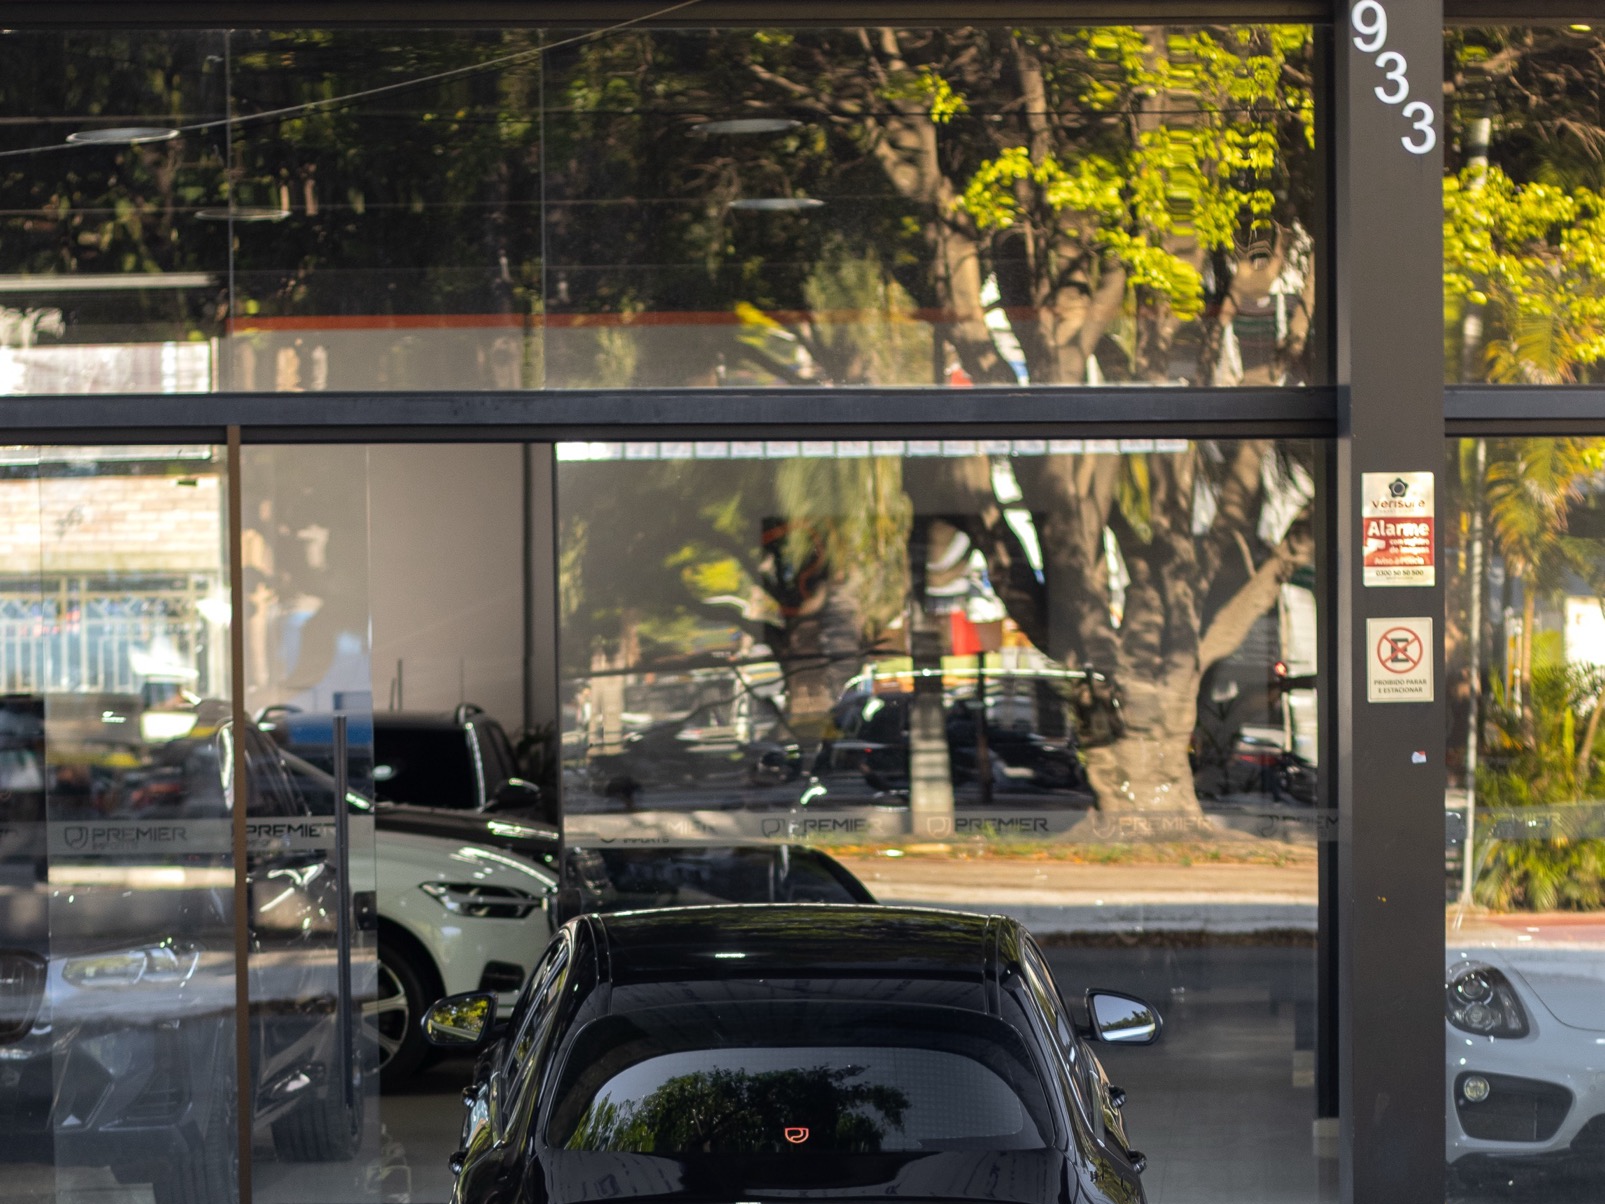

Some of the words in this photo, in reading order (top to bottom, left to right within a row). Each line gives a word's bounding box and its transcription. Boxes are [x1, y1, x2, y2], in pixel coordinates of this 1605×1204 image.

[1367, 519, 1430, 537] Alarme
[1405, 678, 1427, 686] PARAR
[1383, 686, 1423, 694] ESTACIONAR
[956, 817, 1050, 832] PREMIER
[92, 826, 187, 842] PREMIER
